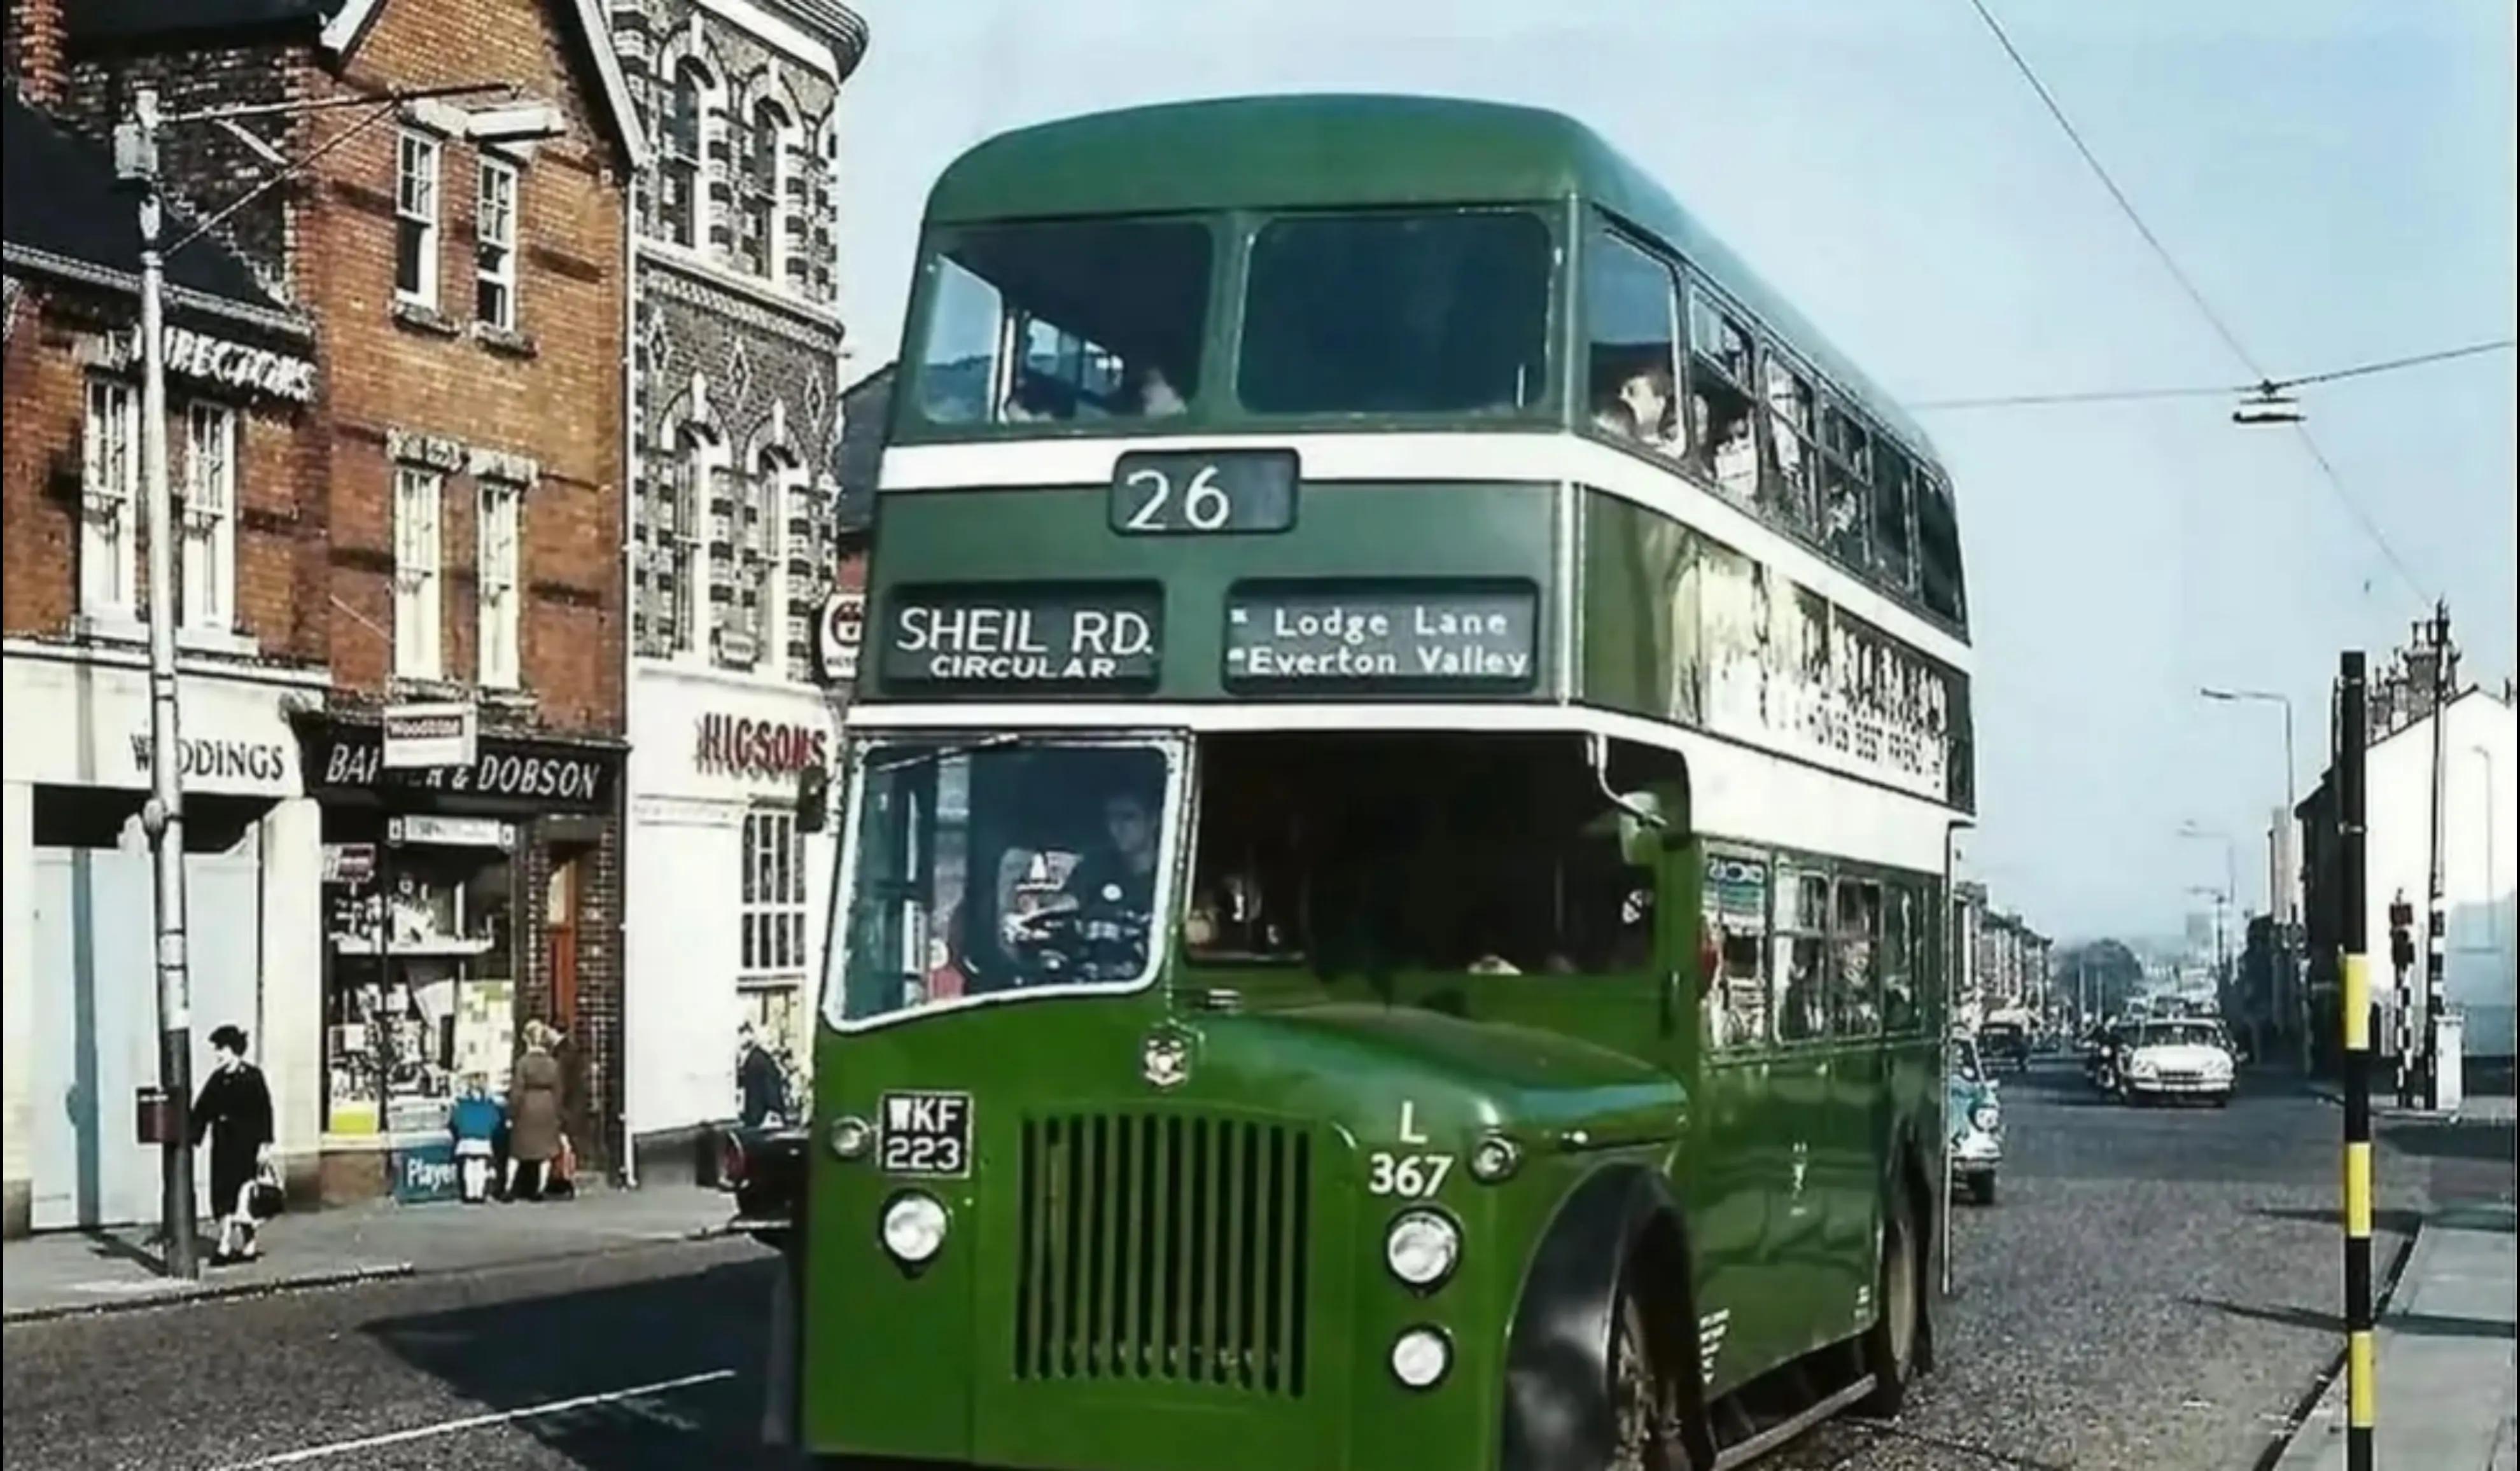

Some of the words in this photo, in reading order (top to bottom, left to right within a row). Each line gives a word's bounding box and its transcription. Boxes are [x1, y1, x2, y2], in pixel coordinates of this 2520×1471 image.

[132, 323, 317, 402] IRECTORS
[1126, 465, 1230, 531] 26
[896, 606, 1049, 653] SHEIL
[1071, 611, 1153, 655] RD.
[1275, 607, 1389, 645] Lodge
[1415, 604, 1508, 635] Lane
[930, 655, 1117, 680] CIRCULAR
[1249, 646, 1397, 674] Everton
[1416, 644, 1528, 677] Valley
[702, 711, 827, 771] HIGSONS
[476, 753, 601, 800] DOBSON
[888, 1098, 963, 1133] WKF
[1399, 1100, 1428, 1144] L
[886, 1136, 960, 1170] 223
[1368, 1152, 1454, 1198] 367
